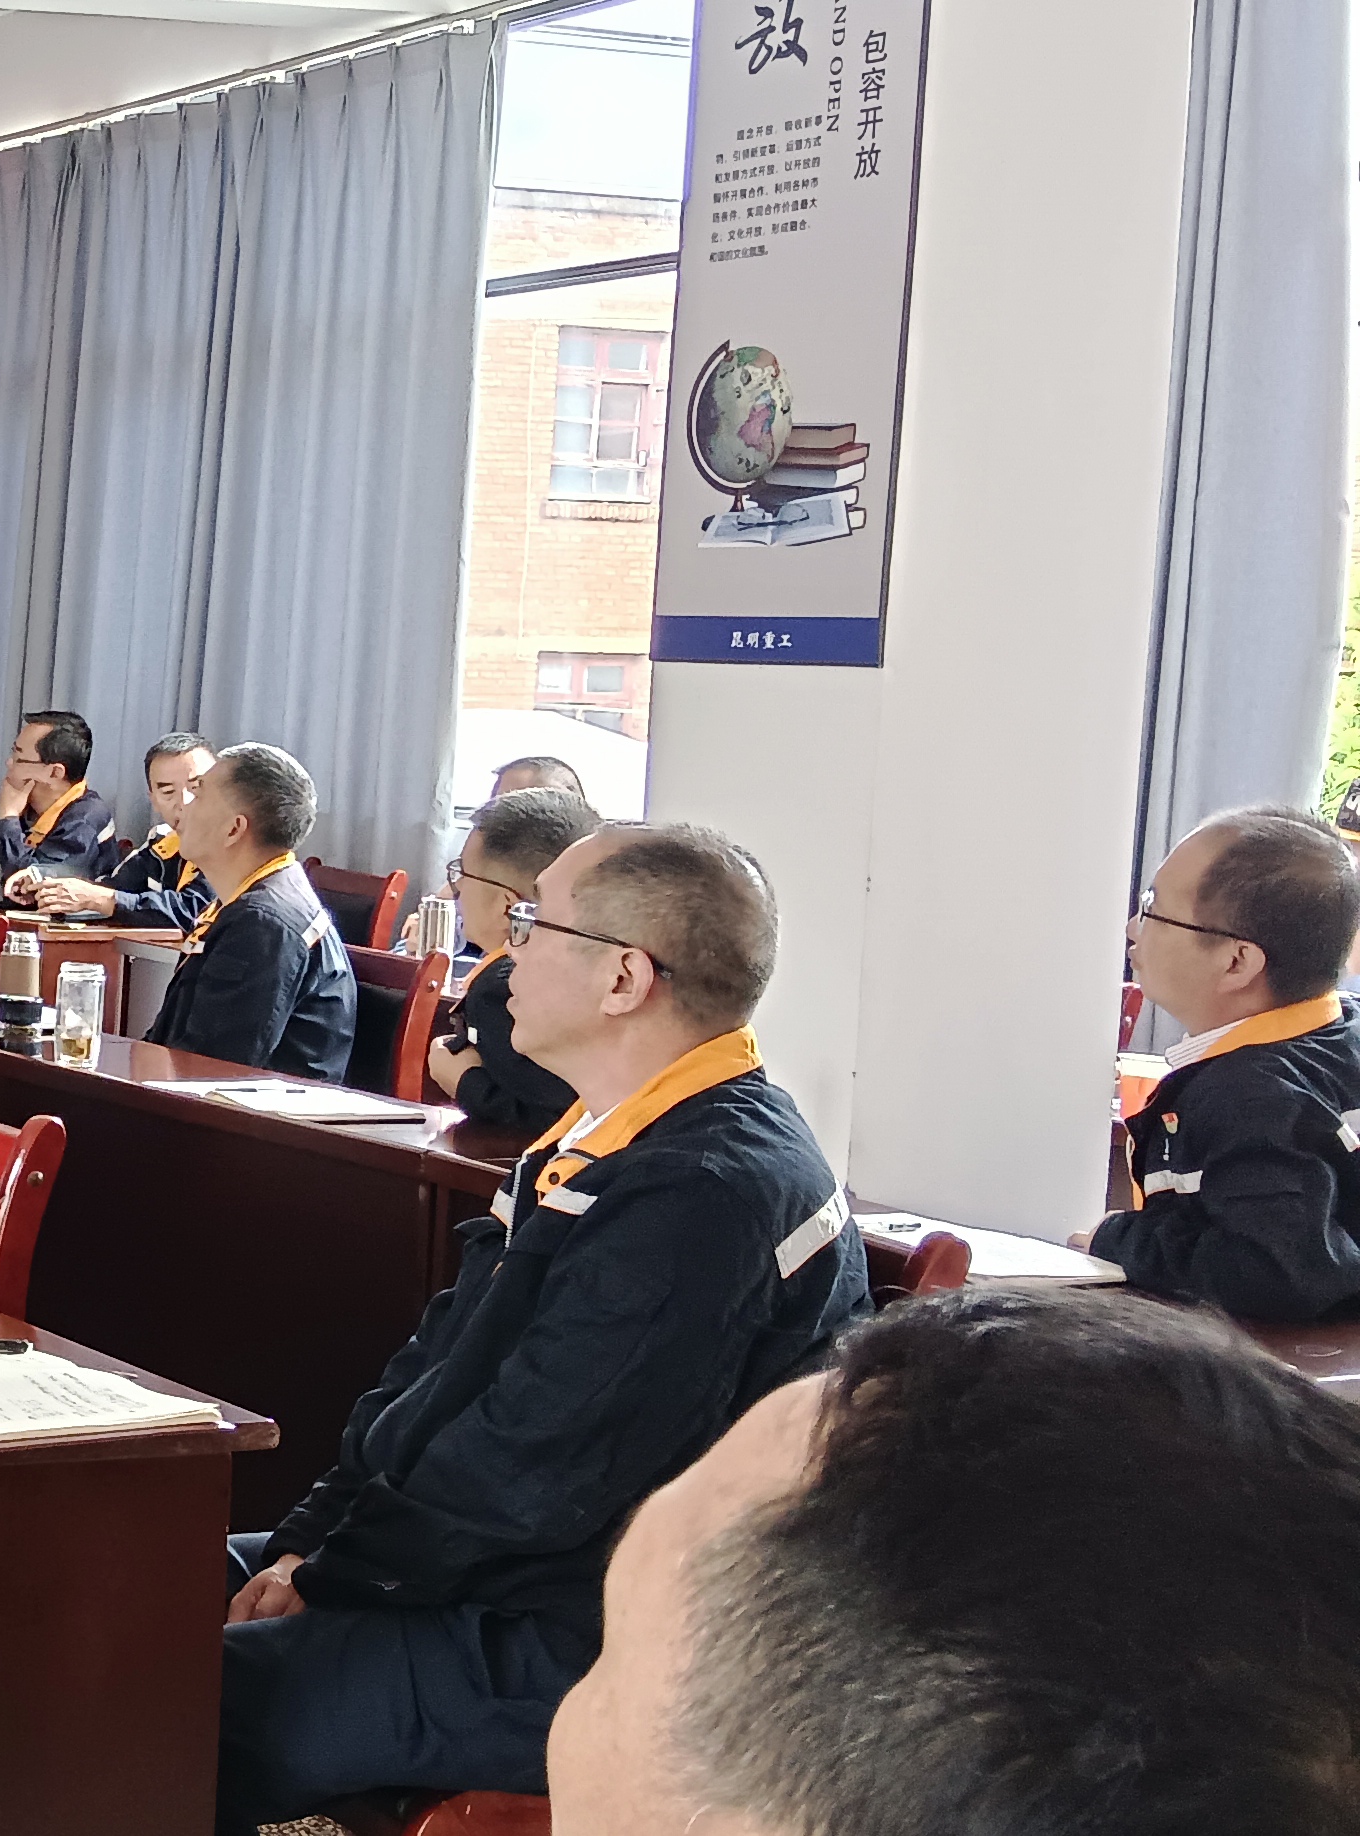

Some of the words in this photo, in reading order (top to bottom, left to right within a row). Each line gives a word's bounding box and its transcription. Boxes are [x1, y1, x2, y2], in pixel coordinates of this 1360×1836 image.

[734, 0, 809, 75] 放
[831, 0, 848, 47] ND
[826, 56, 845, 133] OPEN
[853, 29, 888, 180] 包容开放
[730, 630, 793, 650] 昆明重工
